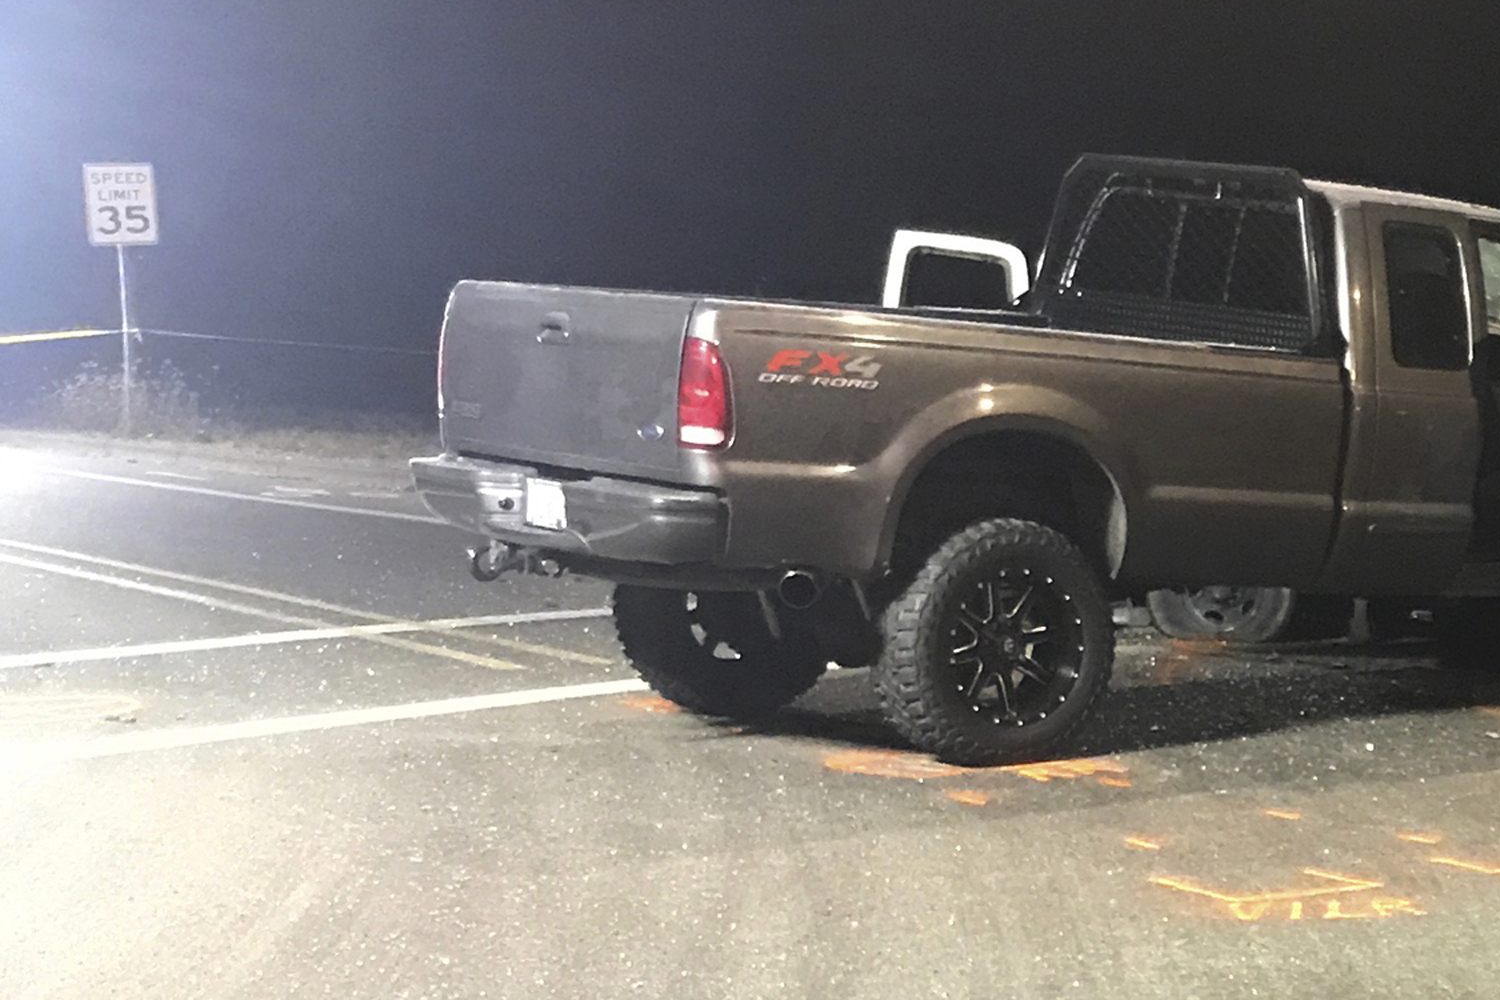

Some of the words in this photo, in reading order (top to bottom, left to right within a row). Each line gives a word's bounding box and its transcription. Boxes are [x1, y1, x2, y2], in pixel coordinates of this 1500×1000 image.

[91, 172, 147, 185] SPEED
[98, 189, 140, 201] LIMIT
[97, 205, 150, 235] 35
[767, 349, 882, 378] FX4
[758, 373, 806, 384] OFF
[812, 376, 880, 390] ROAD
